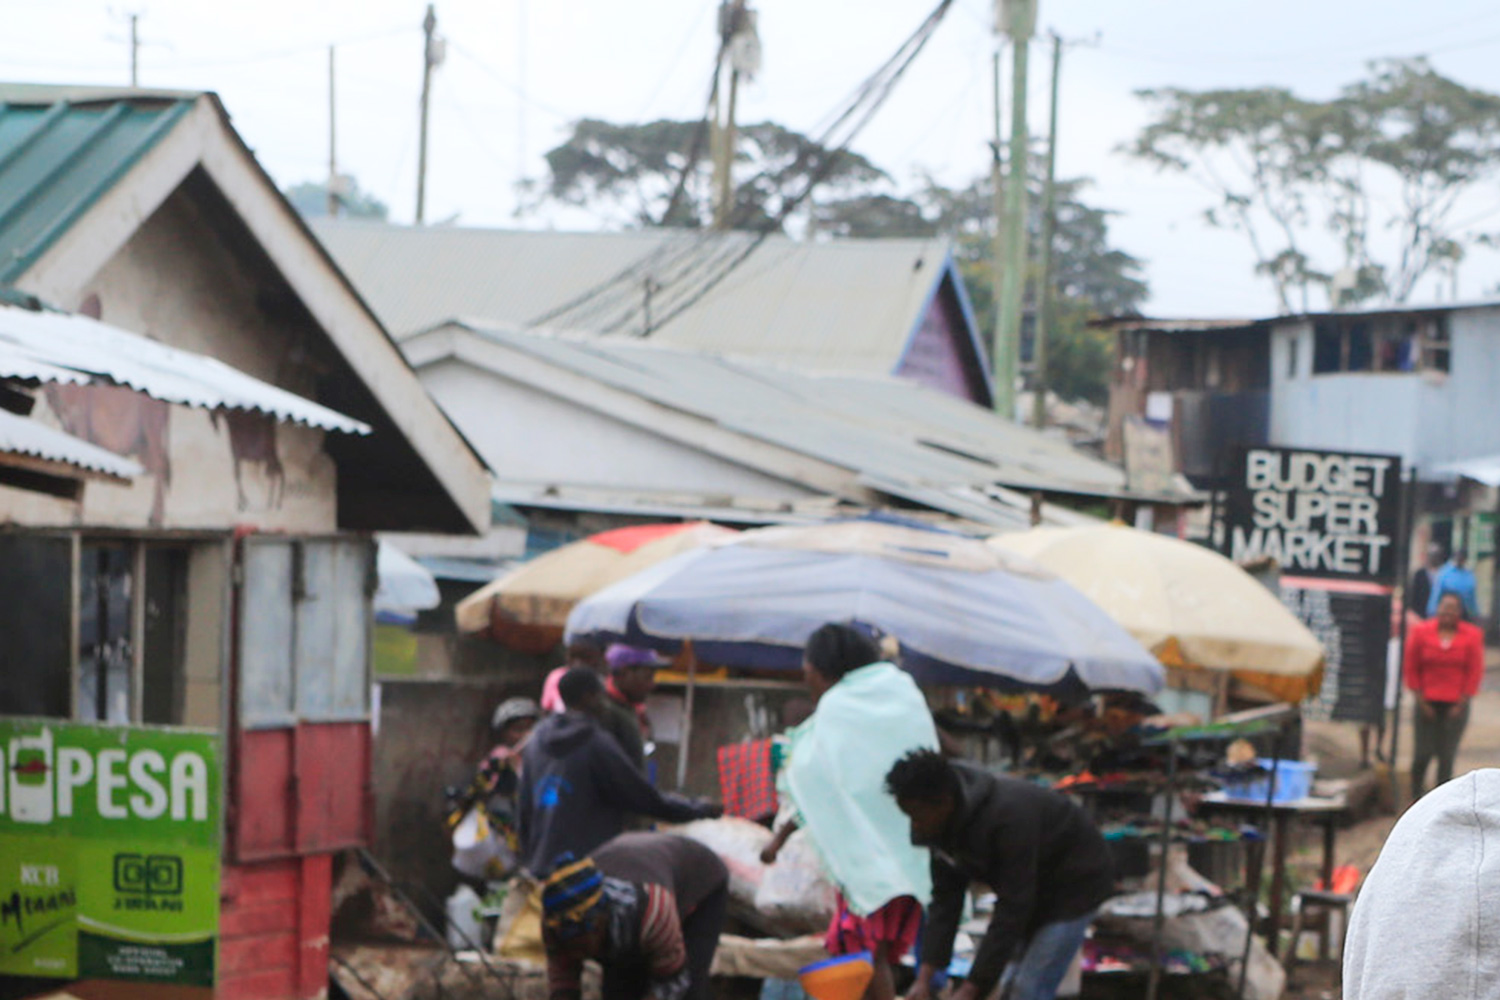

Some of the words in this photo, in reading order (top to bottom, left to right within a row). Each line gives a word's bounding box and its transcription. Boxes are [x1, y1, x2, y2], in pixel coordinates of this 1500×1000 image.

[1247, 450, 1390, 497] BUDGET
[1252, 489, 1379, 536] SUPER
[1231, 526, 1390, 575] MARKET
[20, 865, 59, 886] KCB
